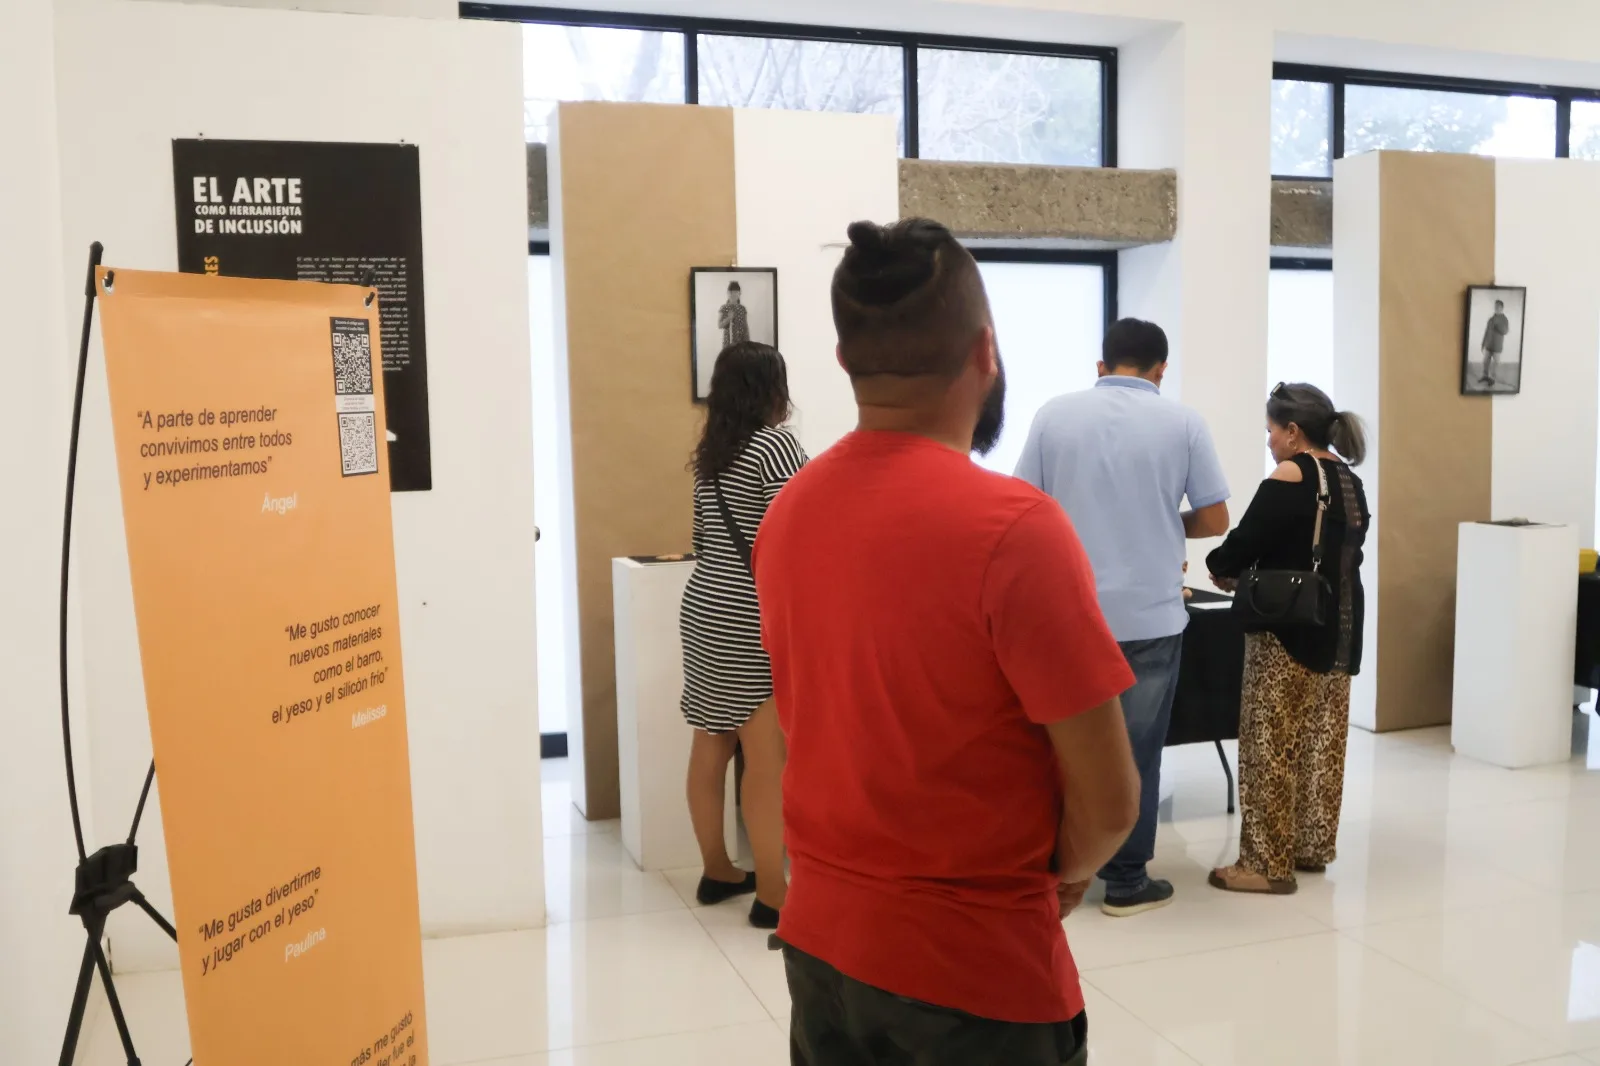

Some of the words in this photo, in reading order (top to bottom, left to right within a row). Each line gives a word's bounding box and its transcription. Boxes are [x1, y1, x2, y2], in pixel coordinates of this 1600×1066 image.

[193, 176, 223, 203] EL
[232, 177, 302, 204] ARTE
[195, 205, 227, 215] COMO
[229, 205, 302, 216] HERRAMIENTA
[195, 219, 214, 234] DE
[219, 216, 302, 234] INCLUSIÓN
[137, 410, 153, 429] “A
[157, 410, 193, 432] parte
[198, 408, 215, 426] de
[219, 405, 277, 428] aprender
[140, 436, 219, 458] convivimos
[222, 432, 256, 451] entre
[259, 429, 292, 448] todos
[144, 471, 152, 491] y
[156, 456, 273, 487] experimentamos”
[285, 623, 307, 641] “Me
[310, 615, 340, 639] gusto
[342, 604, 381, 626] conocer
[289, 643, 330, 667] nuevos
[332, 626, 382, 653] materiales
[313, 663, 343, 684] como
[345, 656, 354, 673] el
[272, 705, 282, 724] el
[286, 698, 313, 723] yeso
[316, 696, 322, 712] y
[325, 686, 335, 705] el
[337, 676, 368, 700] silicón
[351, 704, 388, 729] Melissa
[199, 919, 224, 942] “Me
[228, 898, 262, 932] gusta
[265, 866, 321, 906] divertirme
[202, 955, 210, 976] y
[212, 934, 246, 970] jugar
[249, 920, 271, 943] con
[274, 907, 285, 928] el
[288, 888, 319, 925] yeso”
[285, 927, 326, 963] Paulina
[351, 1047, 371, 1066] más
[374, 1034, 389, 1055] me
[390, 1009, 413, 1044] gustó
[392, 1042, 405, 1061] fue
[406, 1028, 415, 1048] el
